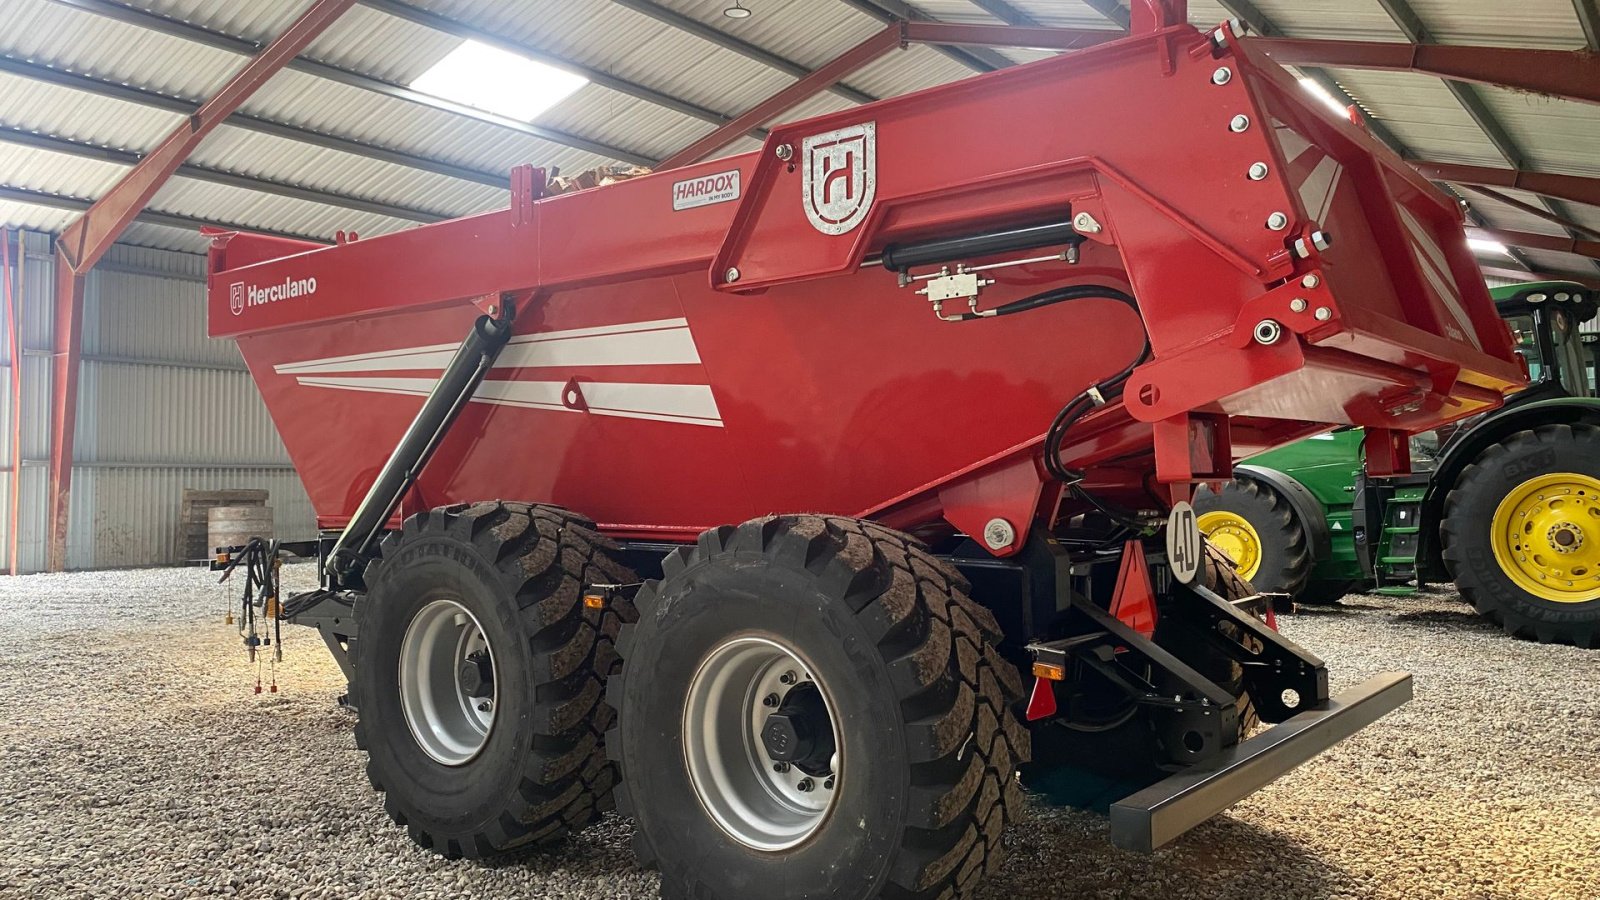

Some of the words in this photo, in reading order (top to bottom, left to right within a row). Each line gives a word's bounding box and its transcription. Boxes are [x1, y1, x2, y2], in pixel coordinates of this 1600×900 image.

[676, 173, 735, 200] HARDOX
[248, 276, 317, 307] Herculano
[1173, 510, 1195, 573] 40
